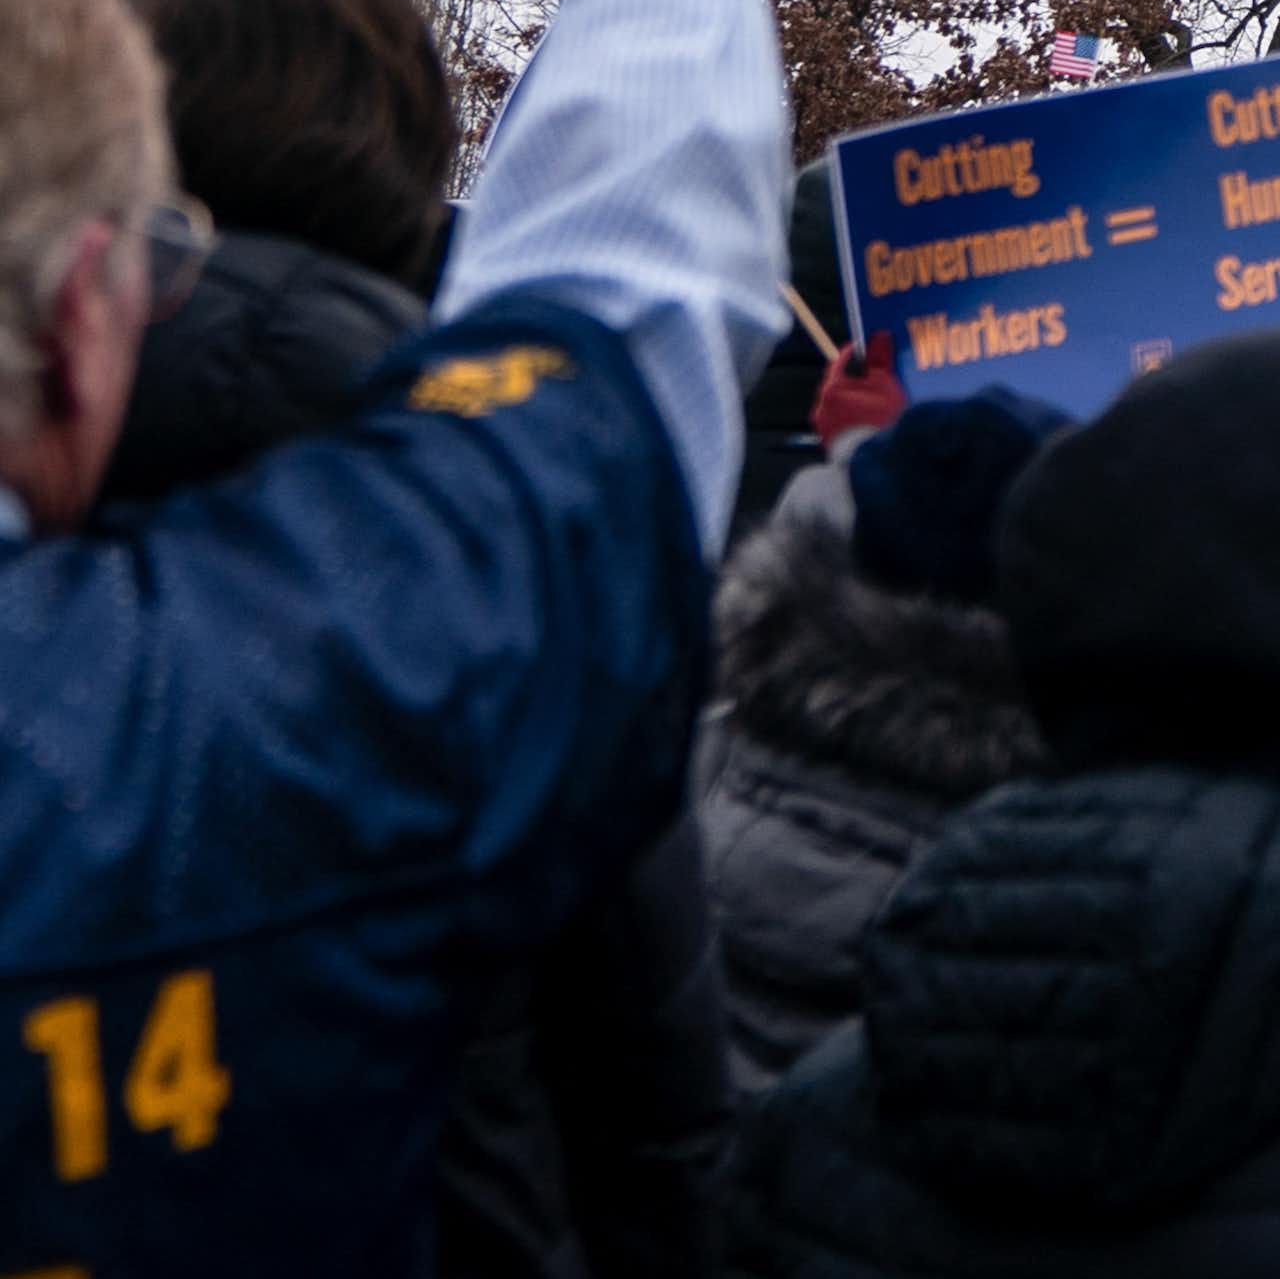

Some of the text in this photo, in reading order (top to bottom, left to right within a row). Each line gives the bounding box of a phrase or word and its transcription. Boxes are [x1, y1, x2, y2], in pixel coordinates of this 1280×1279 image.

[895, 137, 1040, 205] Cutting
[865, 206, 1092, 297] Government
[908, 303, 1066, 370] Workers
[22, 968, 233, 1183] 14
